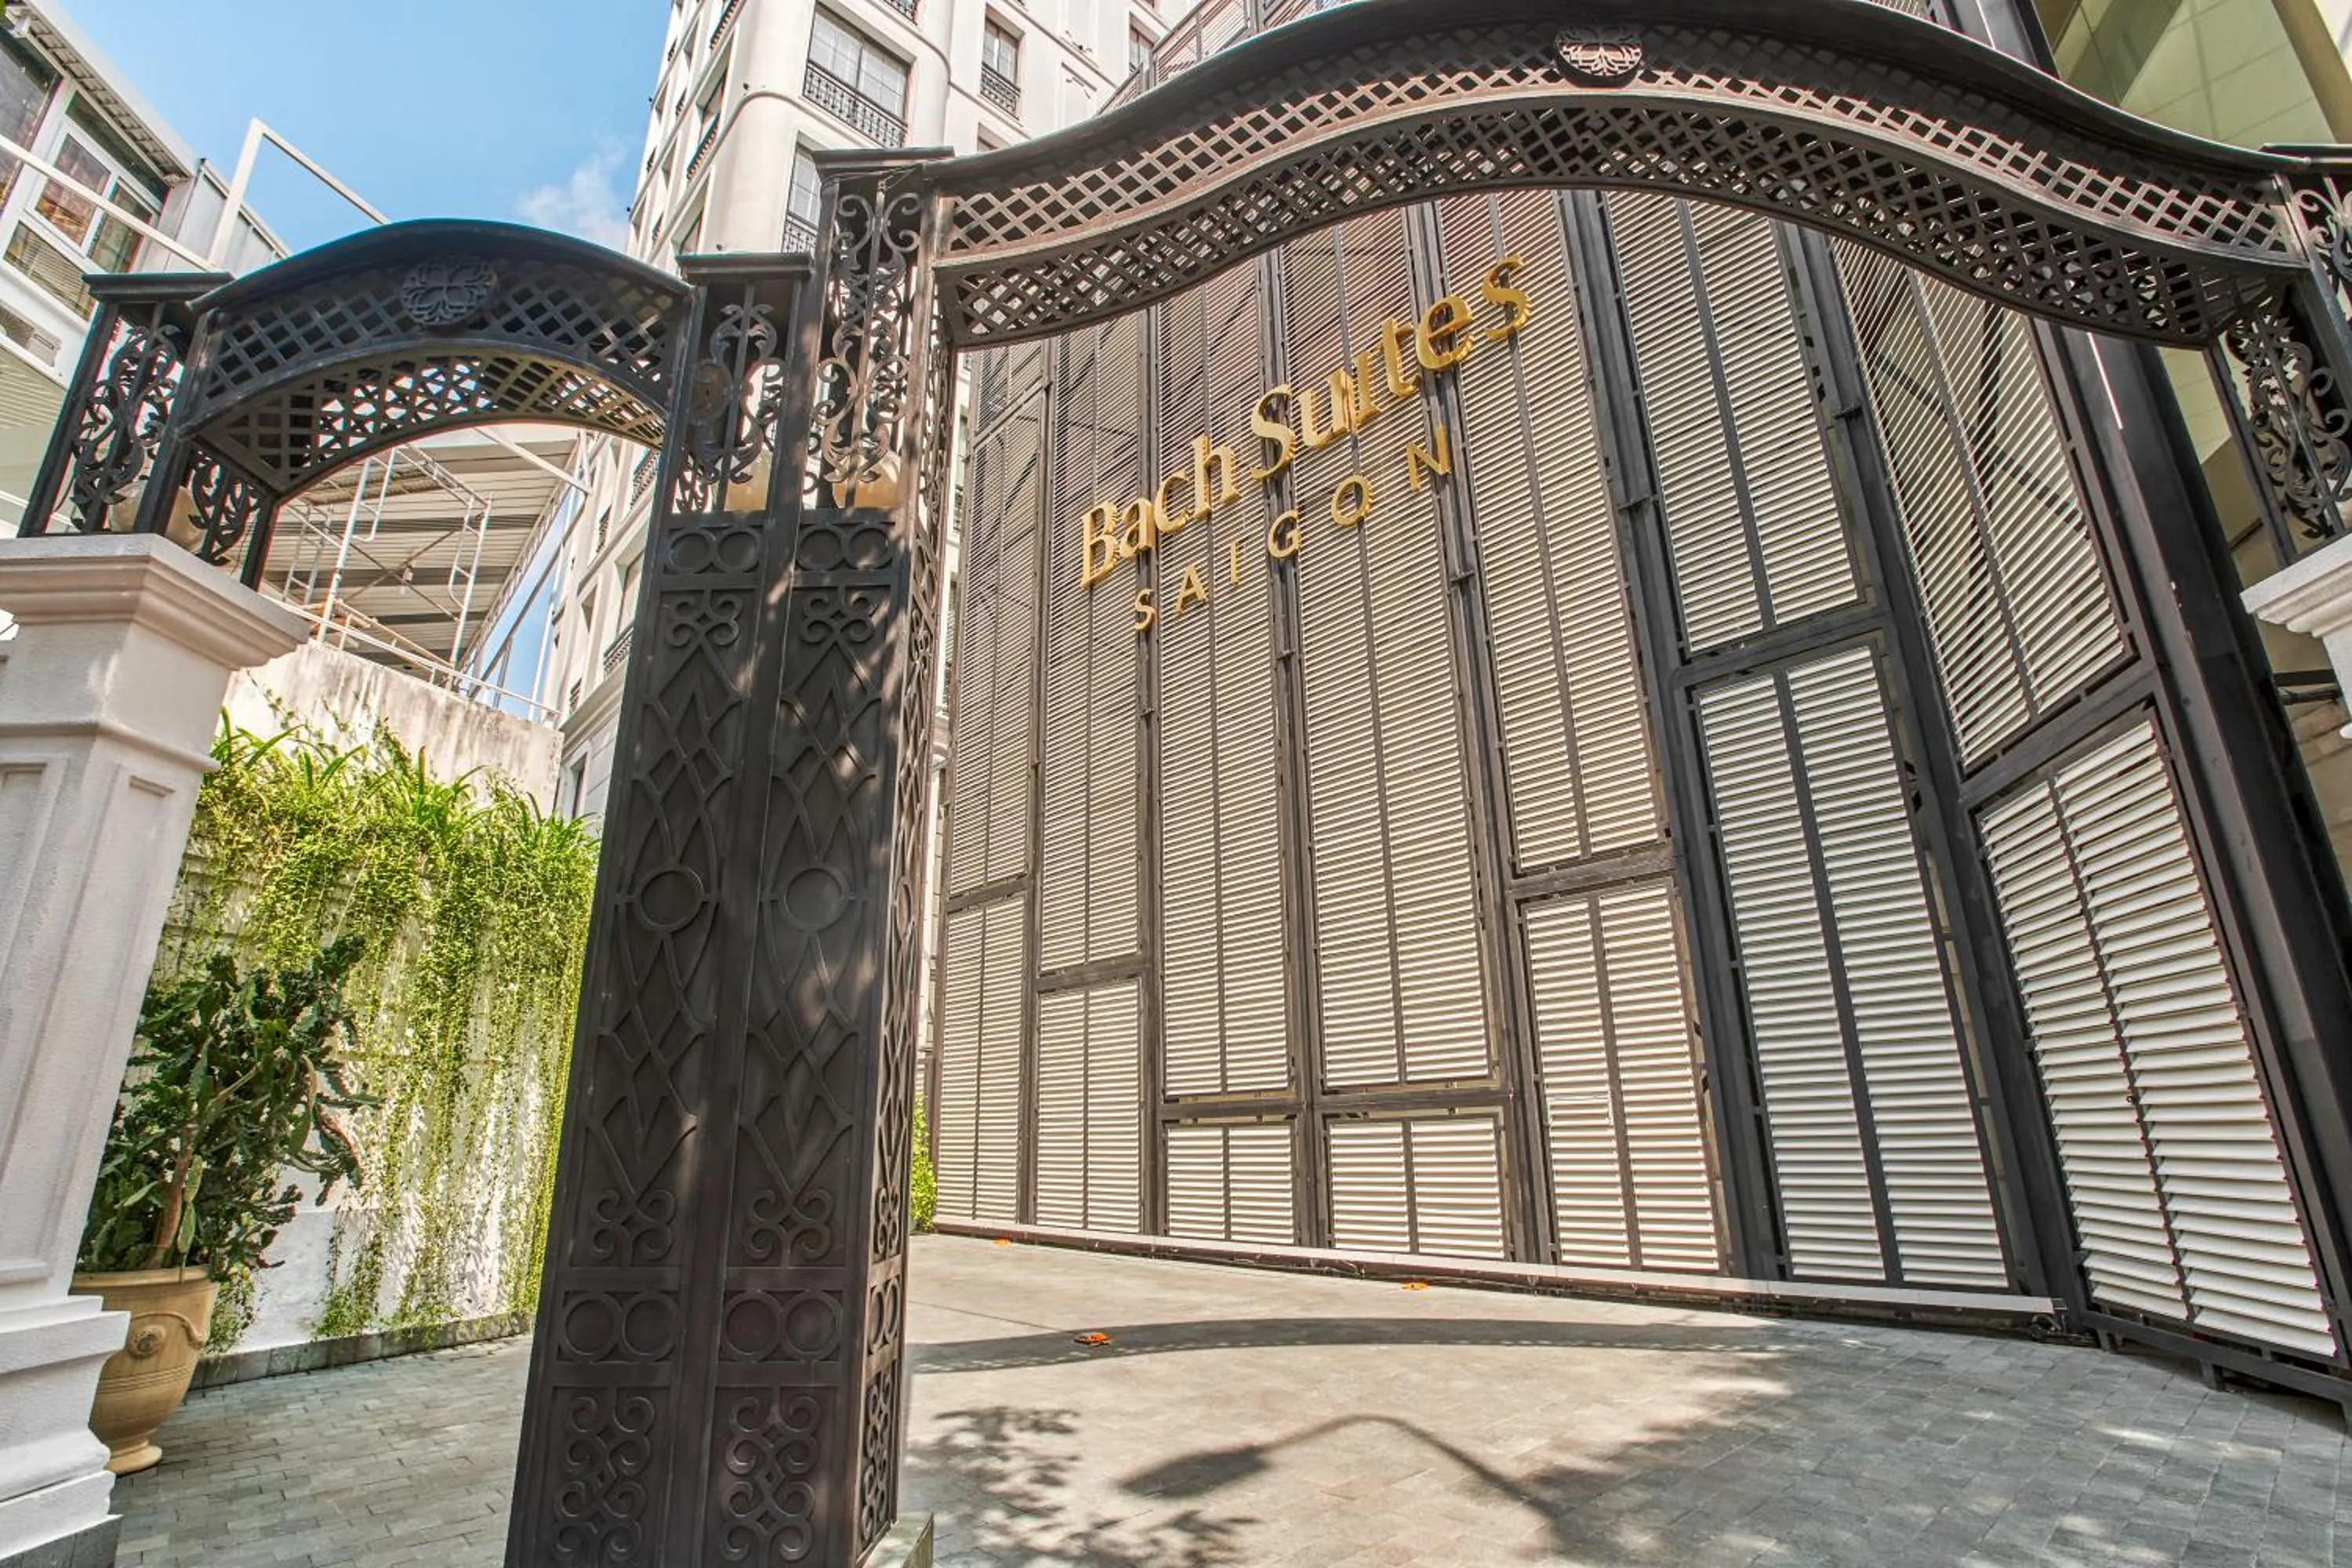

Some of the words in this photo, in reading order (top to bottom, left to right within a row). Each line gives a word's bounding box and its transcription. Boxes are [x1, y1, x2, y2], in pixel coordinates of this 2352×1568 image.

[1080, 434, 1240, 590] Bach
[1250, 253, 1531, 481] Suites
[1134, 425, 1451, 632] SAIGON
